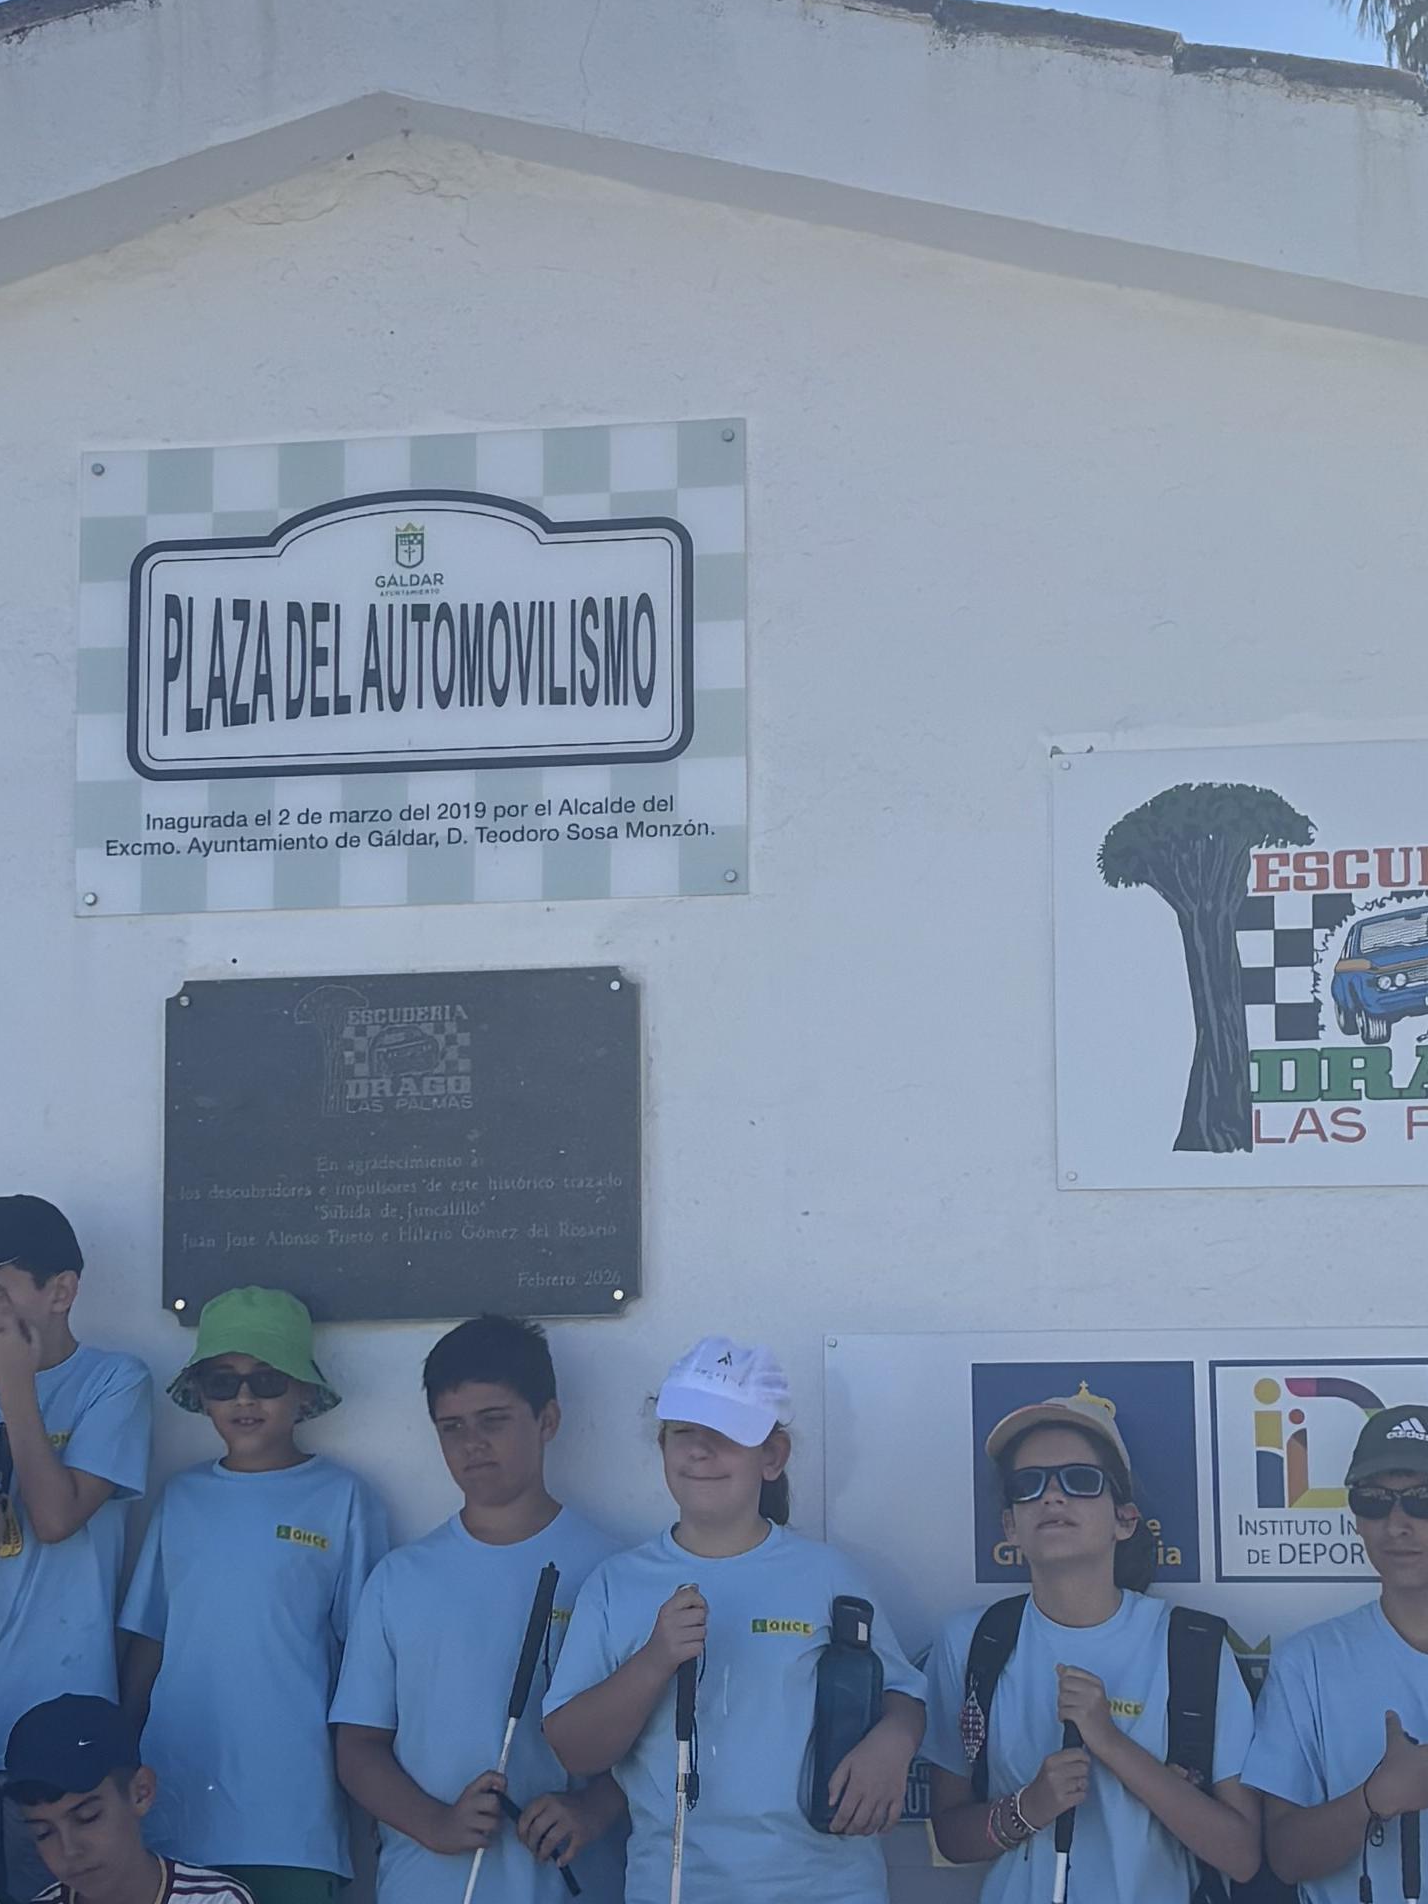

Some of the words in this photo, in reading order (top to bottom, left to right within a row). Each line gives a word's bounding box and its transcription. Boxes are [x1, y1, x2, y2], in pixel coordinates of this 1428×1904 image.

[162, 594, 274, 736] PLAZA
[286, 601, 351, 719] DEL
[360, 591, 657, 713] AUTOMOVILISMO
[146, 809, 249, 834] Inagurada
[254, 808, 273, 826] el
[279, 807, 291, 825] 2
[298, 805, 320, 824] de
[326, 808, 394, 824] marzo
[399, 802, 431, 821] del
[436, 801, 487, 821] 2019
[493, 804, 529, 825] por
[534, 798, 552, 817] el
[558, 796, 635, 817] Alcalde
[641, 795, 675, 814] del
[105, 838, 181, 857] Excmo.
[187, 832, 328, 858] Ayuntamiento
[335, 831, 361, 849] de
[367, 828, 440, 851] Gáldar,
[447, 827, 469, 846] D.
[477, 823, 560, 845] Teodoro
[566, 822, 619, 841] Sosa
[625, 818, 716, 839] Monzón.
[347, 1005, 468, 1025] ESCUDERIA
[346, 1077, 472, 1099] DRAGO
[346, 1099, 384, 1114] LAS
[395, 1096, 473, 1112] PALMAS
[1254, 1107, 1366, 1144] LAS
[1238, 1514, 1332, 1537] INSTITUTO
[293, 1528, 328, 1548] ONCE
[1248, 1549, 1270, 1565] DE
[1279, 1543, 1364, 1564] DEPOR
[769, 1620, 813, 1635] ONCE
